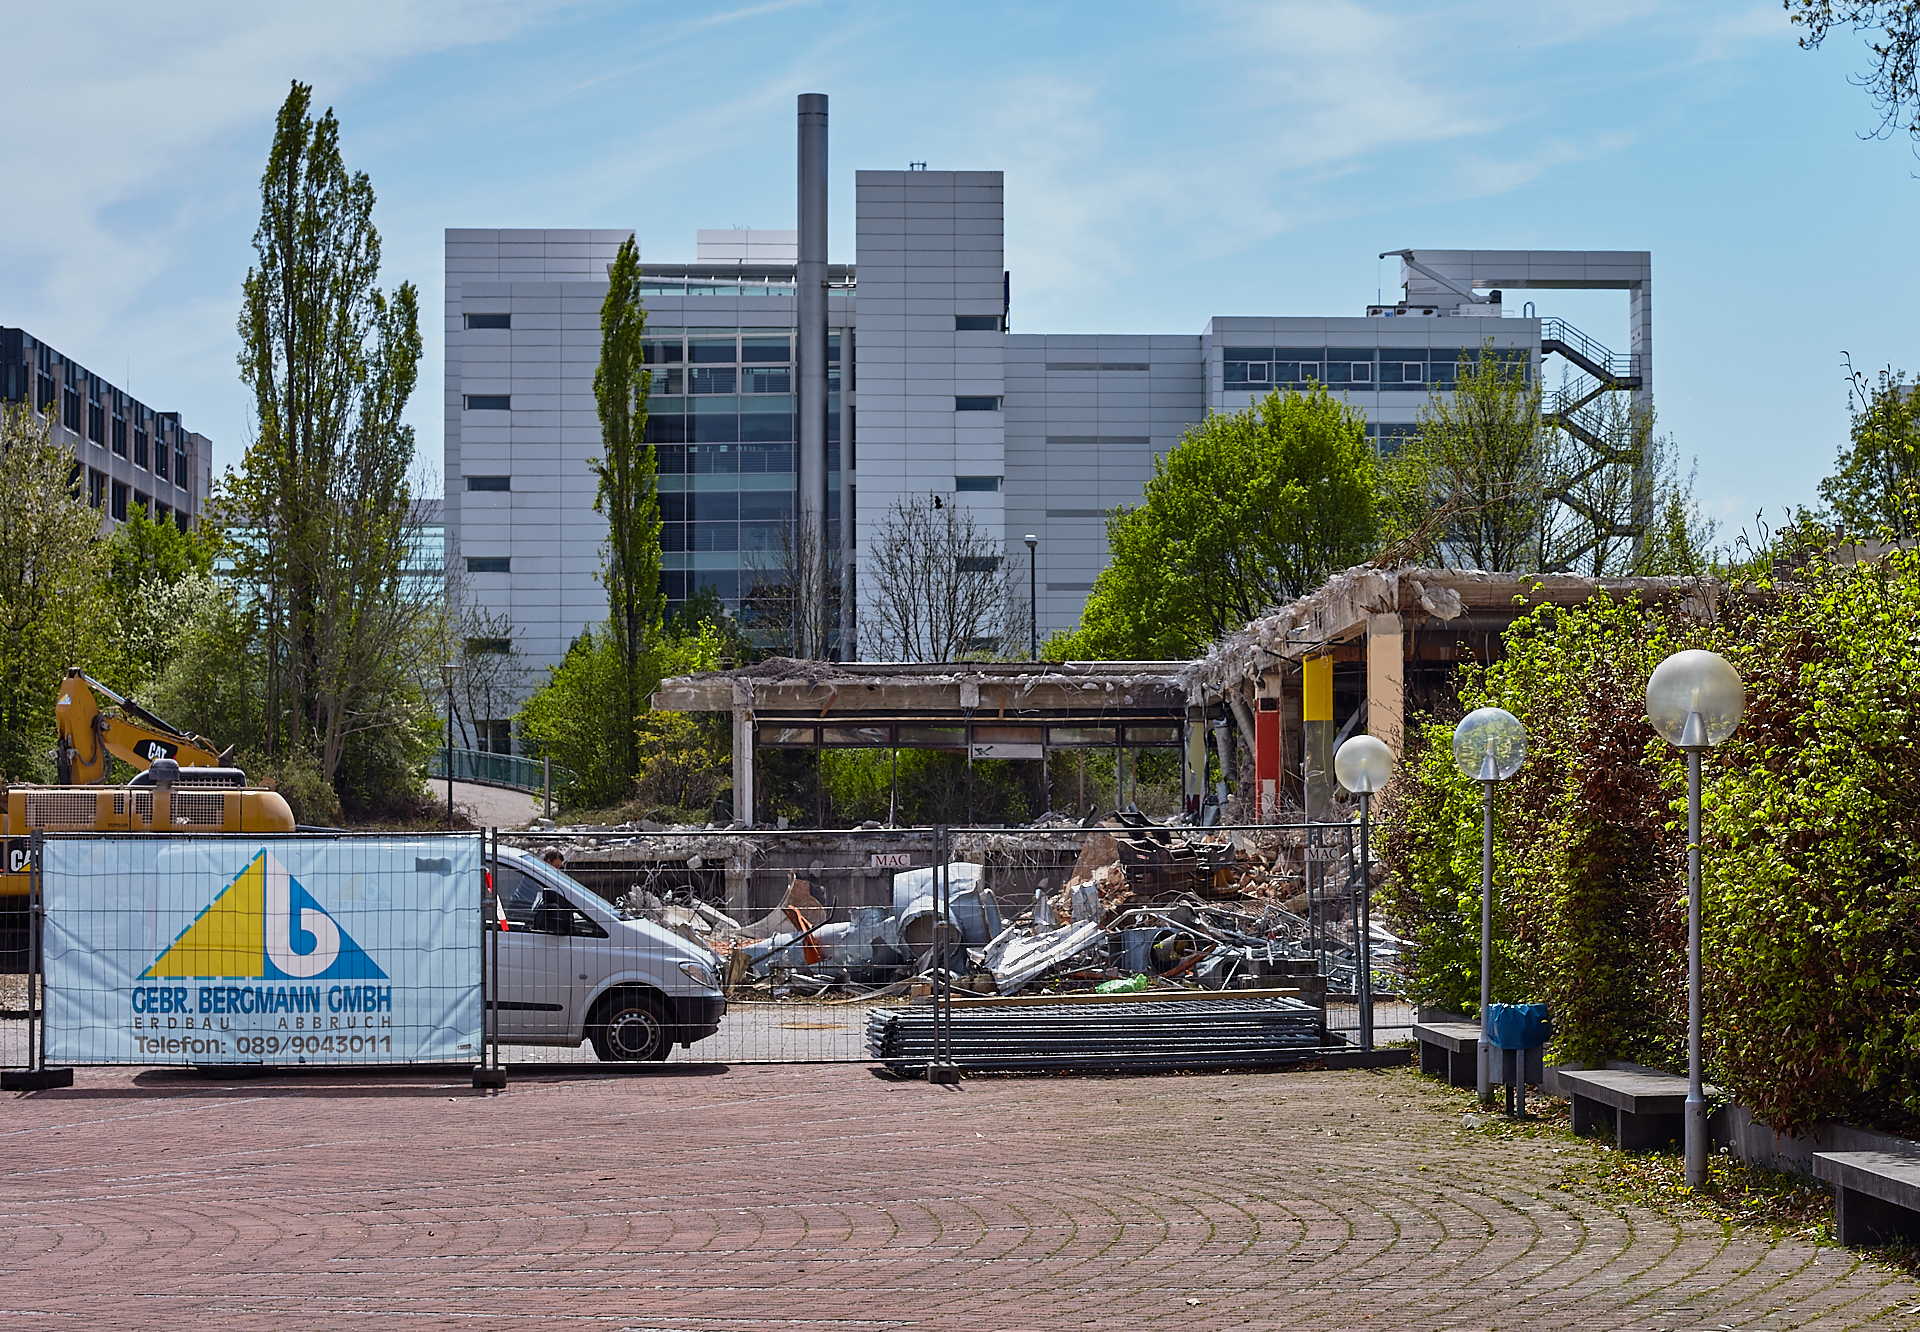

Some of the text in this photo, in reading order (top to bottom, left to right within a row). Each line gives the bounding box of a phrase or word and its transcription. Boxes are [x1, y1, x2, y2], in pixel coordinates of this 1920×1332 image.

[147, 741, 168, 759] CAT
[875, 854, 908, 866] MAC
[1307, 848, 1339, 860] MAC
[132, 985, 391, 1014] GEBR. BERGMANN GMBH
[134, 1015, 391, 1030] ERDBAU ABBRUCH
[134, 1035, 391, 1056] Telefon: 089/9043011
